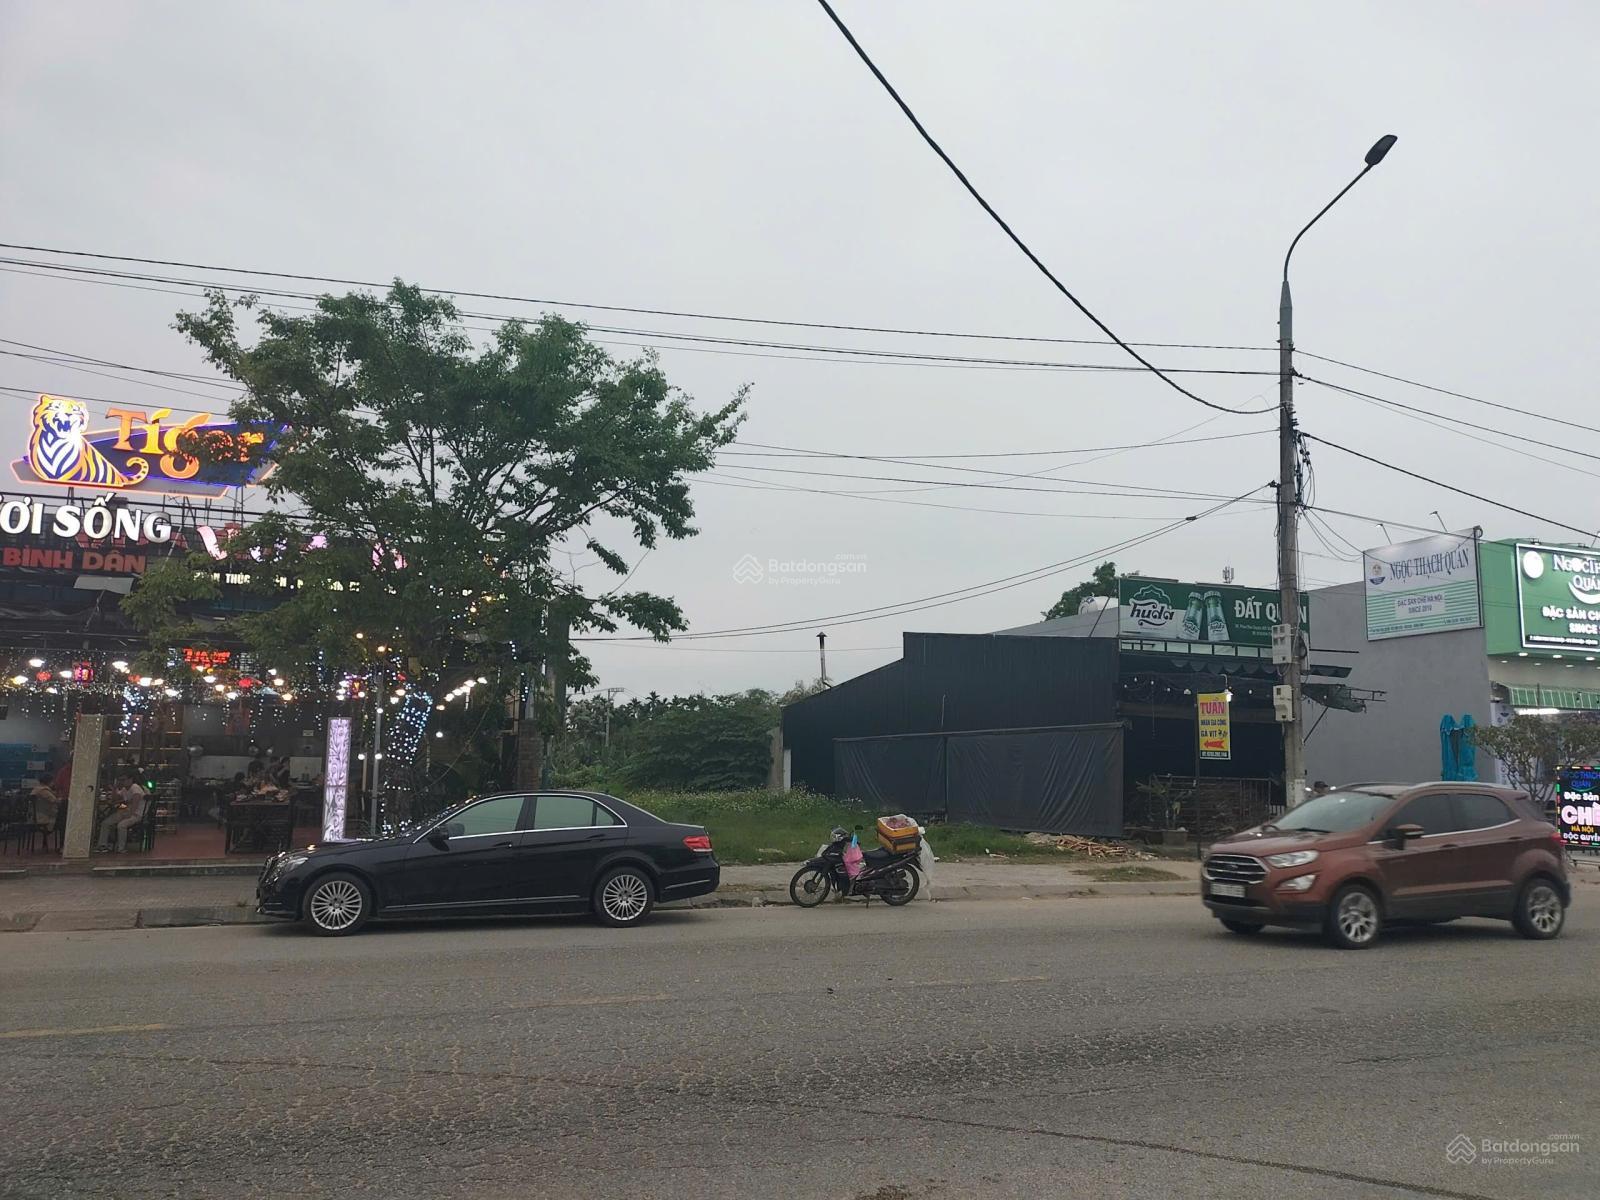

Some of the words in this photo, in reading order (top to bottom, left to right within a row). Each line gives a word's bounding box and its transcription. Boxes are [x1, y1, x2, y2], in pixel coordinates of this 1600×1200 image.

[0, 494, 44, 534] ƠI
[53, 492, 172, 543] SỐNG
[82, 550, 146, 575] DÂN
[1234, 596, 1263, 620] ĐẤT
